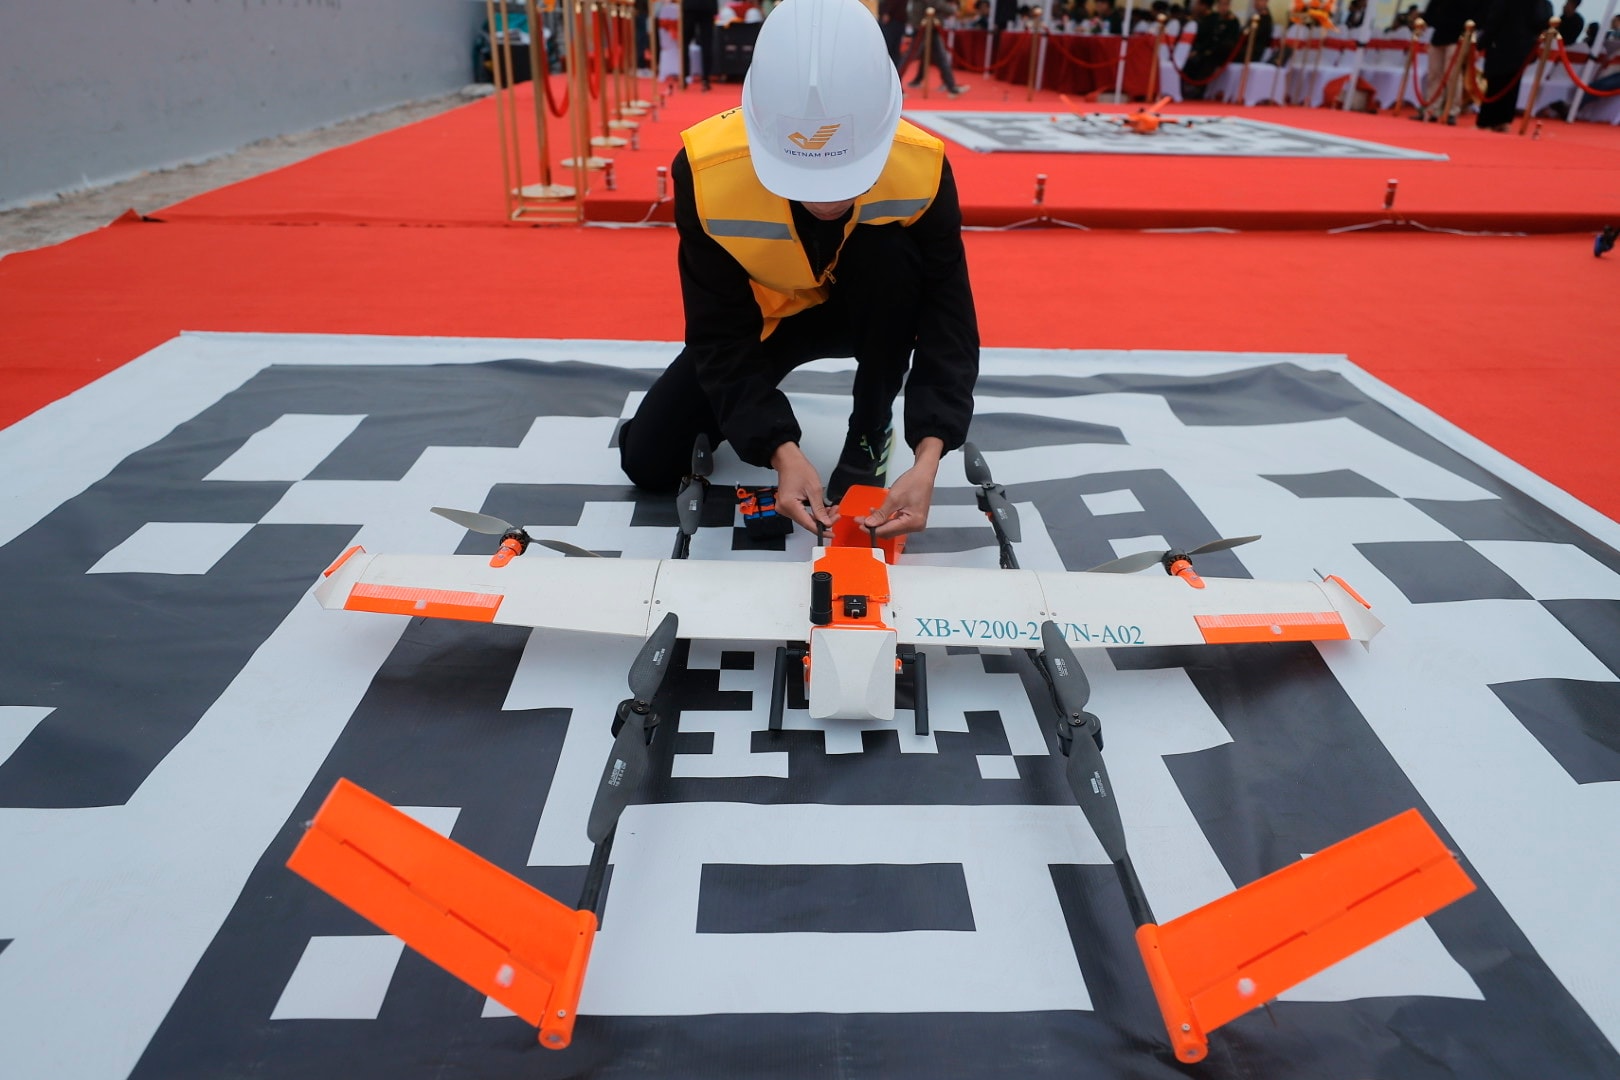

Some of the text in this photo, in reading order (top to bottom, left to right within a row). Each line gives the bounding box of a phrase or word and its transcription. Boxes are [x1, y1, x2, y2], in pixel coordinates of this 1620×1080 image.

[784, 149, 848, 157] VIETNAM POST
[915, 617, 1144, 645] XB-V200-2VN-A02
